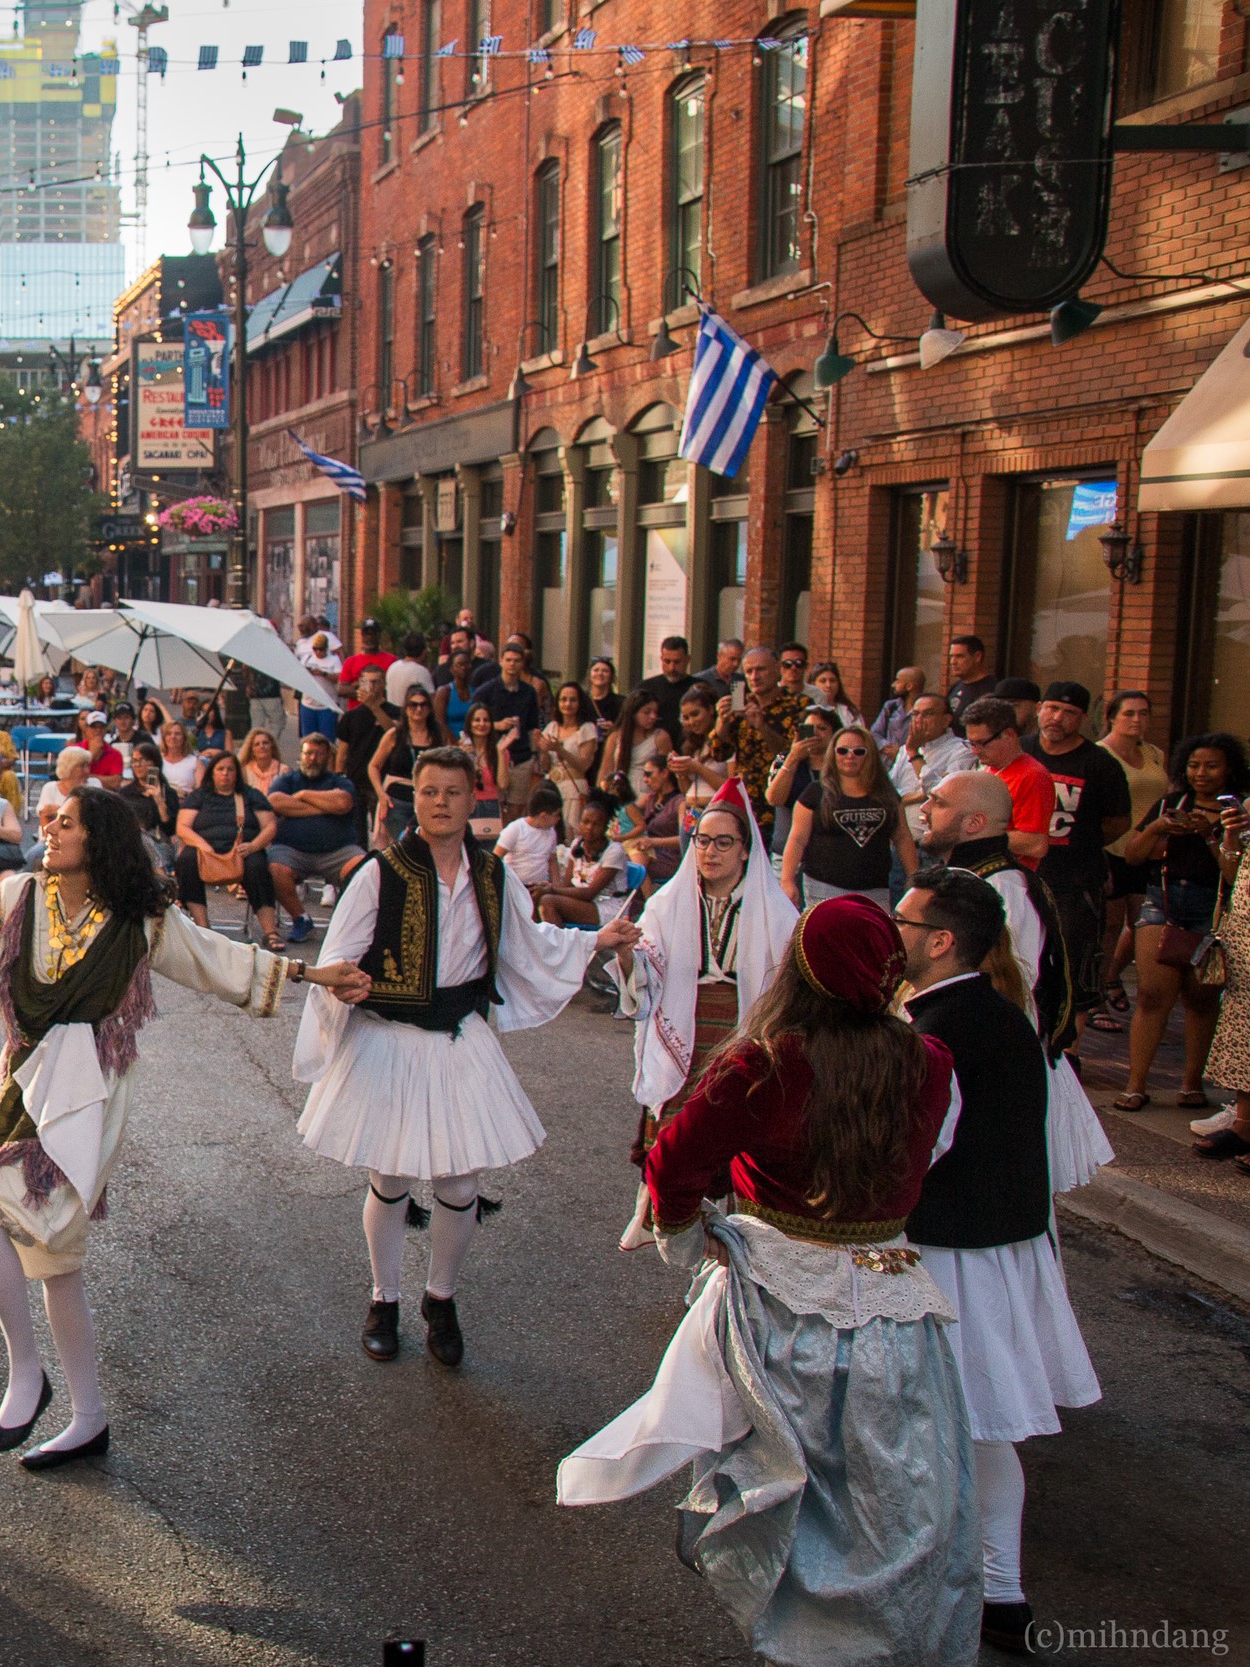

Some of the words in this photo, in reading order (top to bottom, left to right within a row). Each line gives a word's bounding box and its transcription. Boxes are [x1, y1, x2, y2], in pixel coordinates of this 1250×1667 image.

[141, 430, 179, 439] AMERICAN
[182, 429, 210, 439] CUISINE
[839, 811, 881, 824] GUESS
